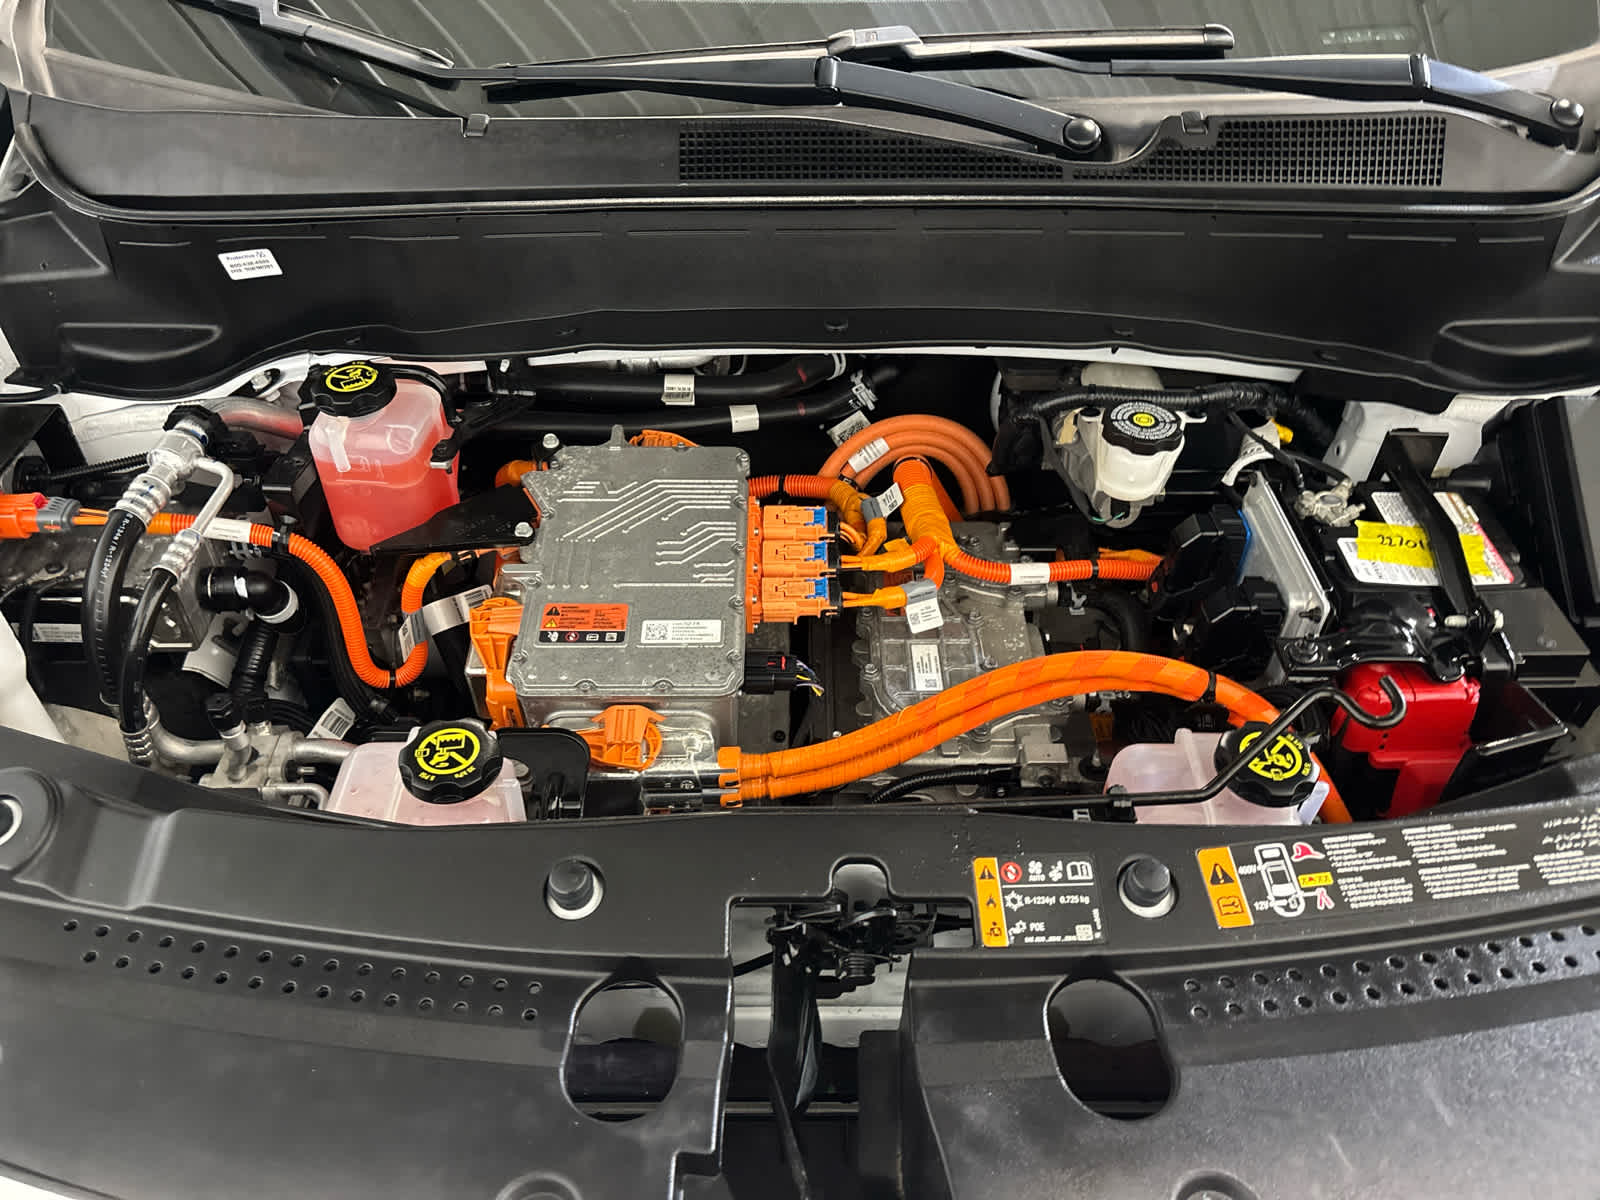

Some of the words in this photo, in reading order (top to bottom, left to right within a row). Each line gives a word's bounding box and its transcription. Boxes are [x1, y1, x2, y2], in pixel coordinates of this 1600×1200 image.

[1029, 874, 1045, 882] AUTO
[1024, 895, 1056, 906] R-1234yf
[1059, 895, 1079, 905] 0.725
[1080, 895, 1090, 905] kg
